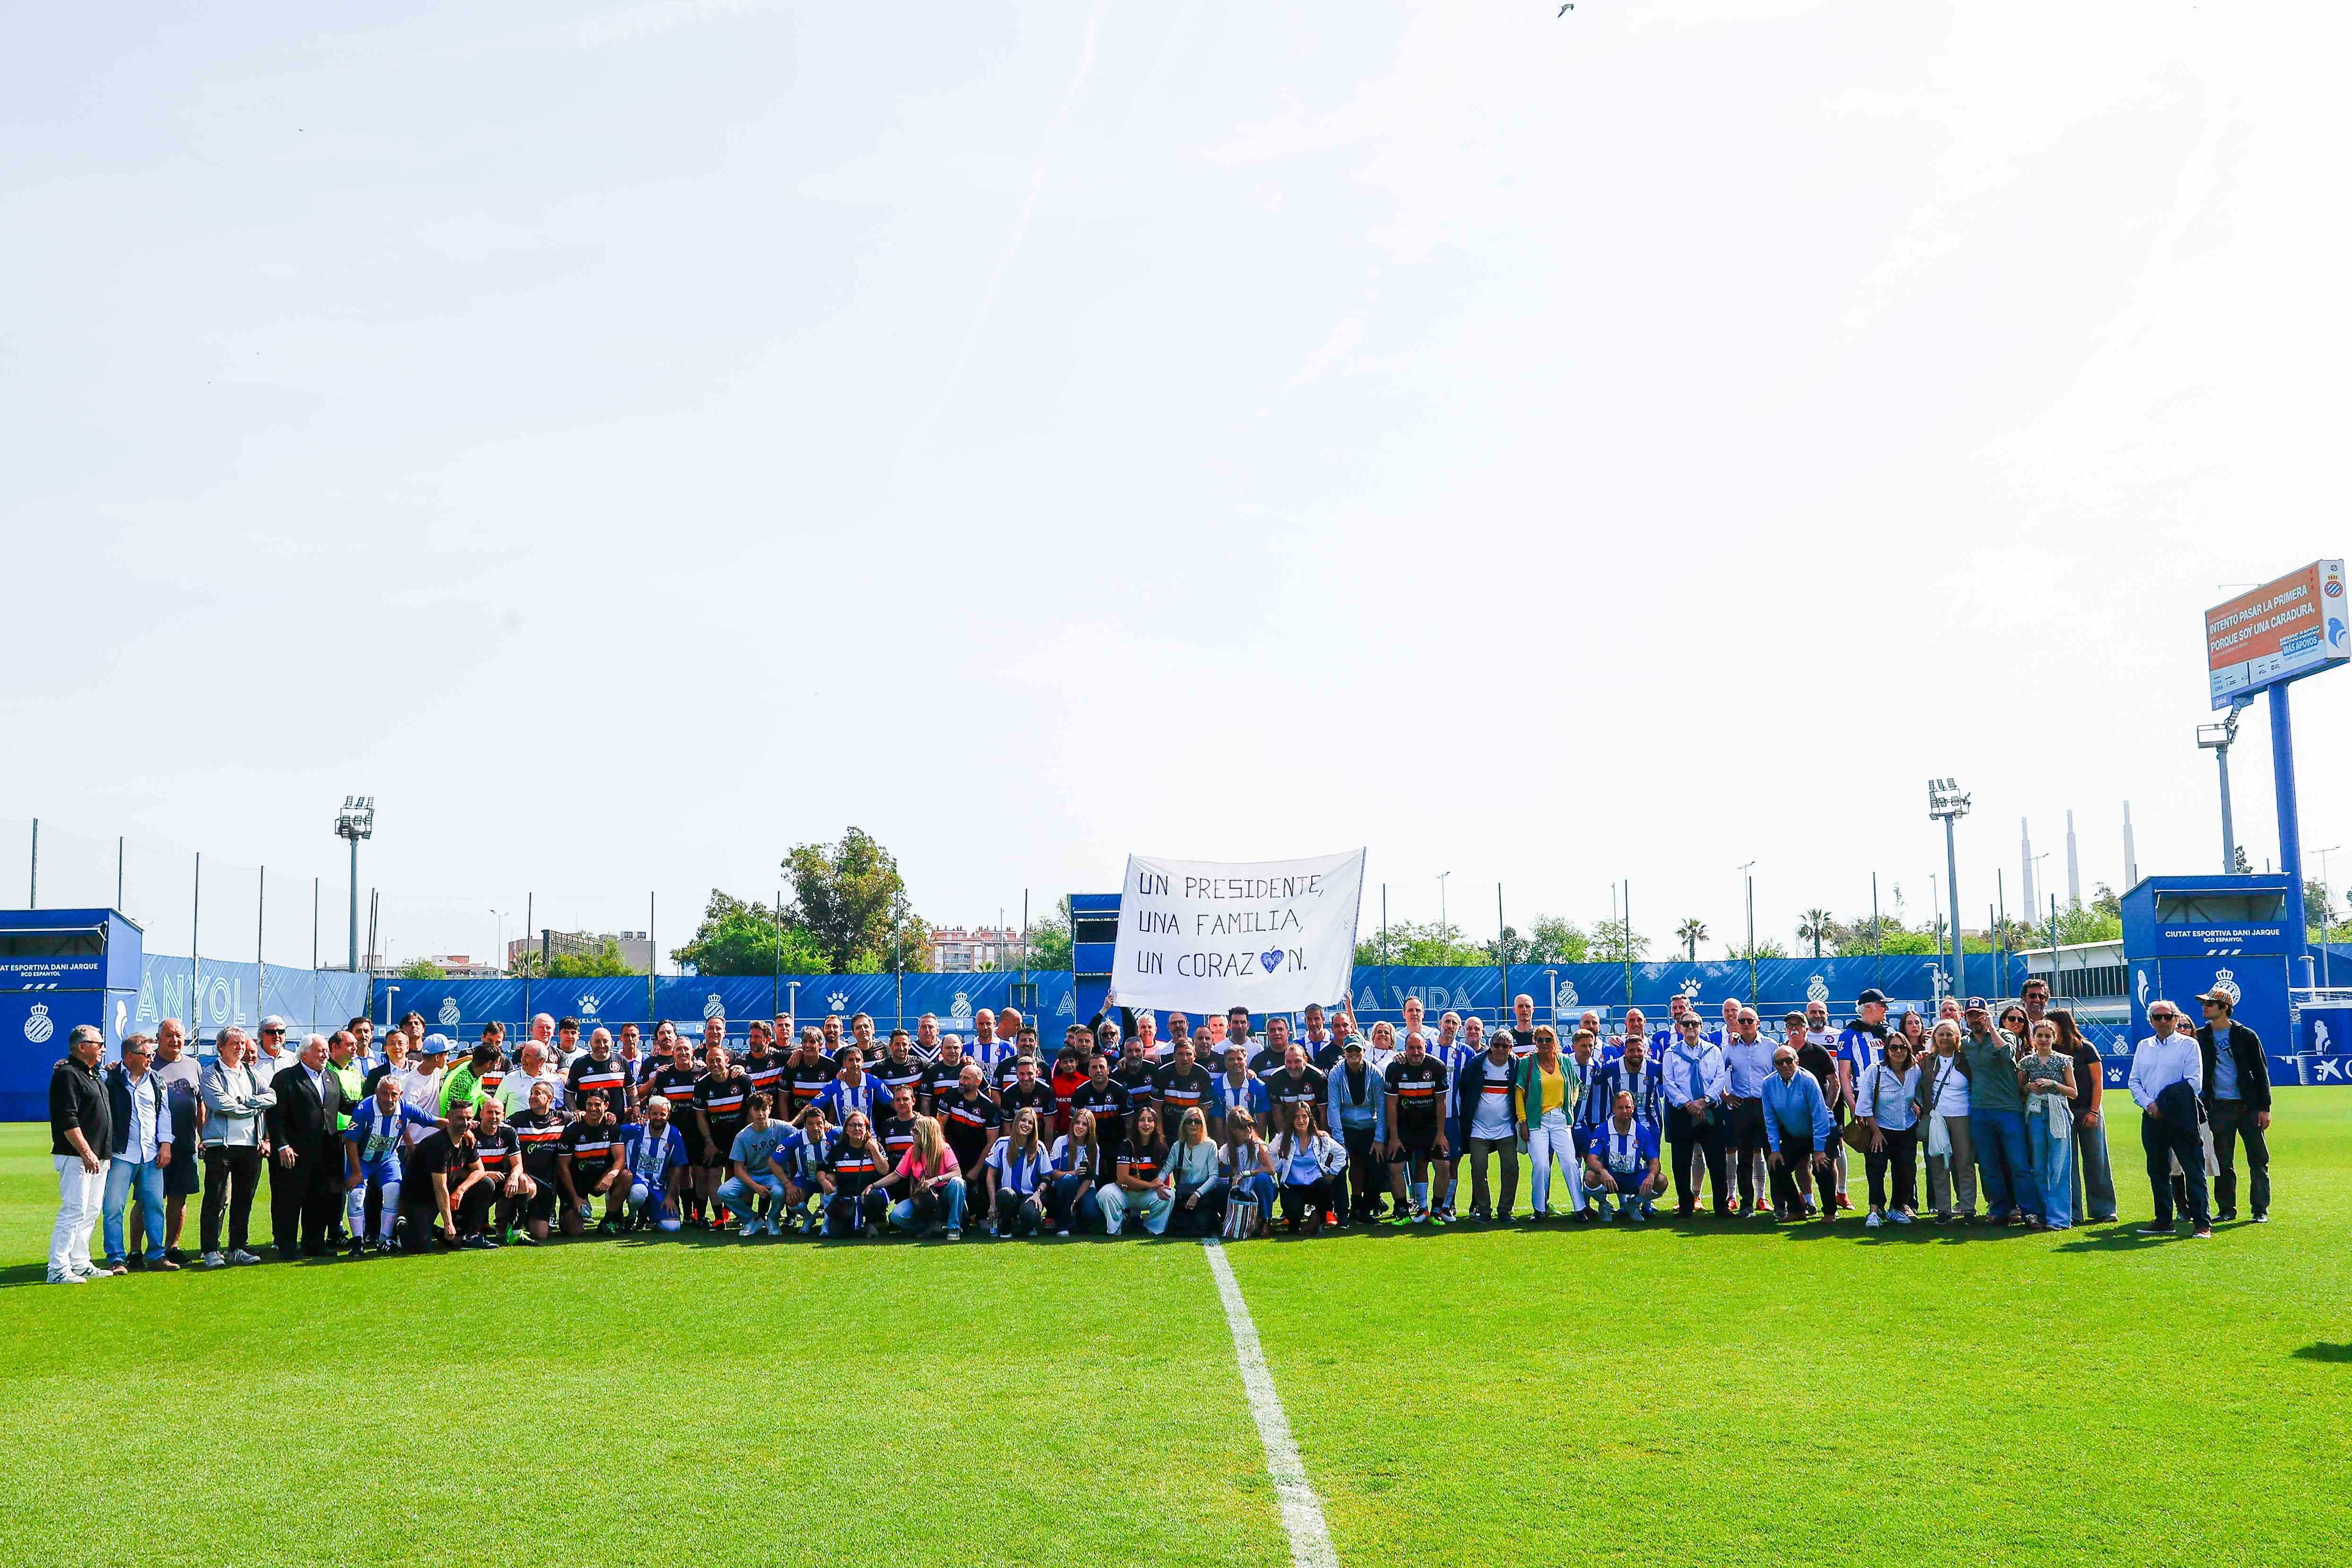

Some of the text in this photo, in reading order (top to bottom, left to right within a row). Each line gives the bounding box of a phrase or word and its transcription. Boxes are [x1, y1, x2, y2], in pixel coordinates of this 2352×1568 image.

[2210, 614, 2239, 635] INTENTO
[2239, 604, 2262, 623] PASAR
[2262, 599, 2274, 612] LA
[2274, 585, 2308, 608] PRIMERA
[2211, 632, 2239, 652] PORQUE
[2254, 620, 2269, 634] UNA
[2295, 636, 2318, 651] APOYOS
[1140, 873, 1324, 899] UN PRESIDENTE,
[1139, 909, 1304, 936] UNA FAMILIA,
[1138, 950, 1162, 974] UN
[1392, 986, 1474, 1011] VIDA
